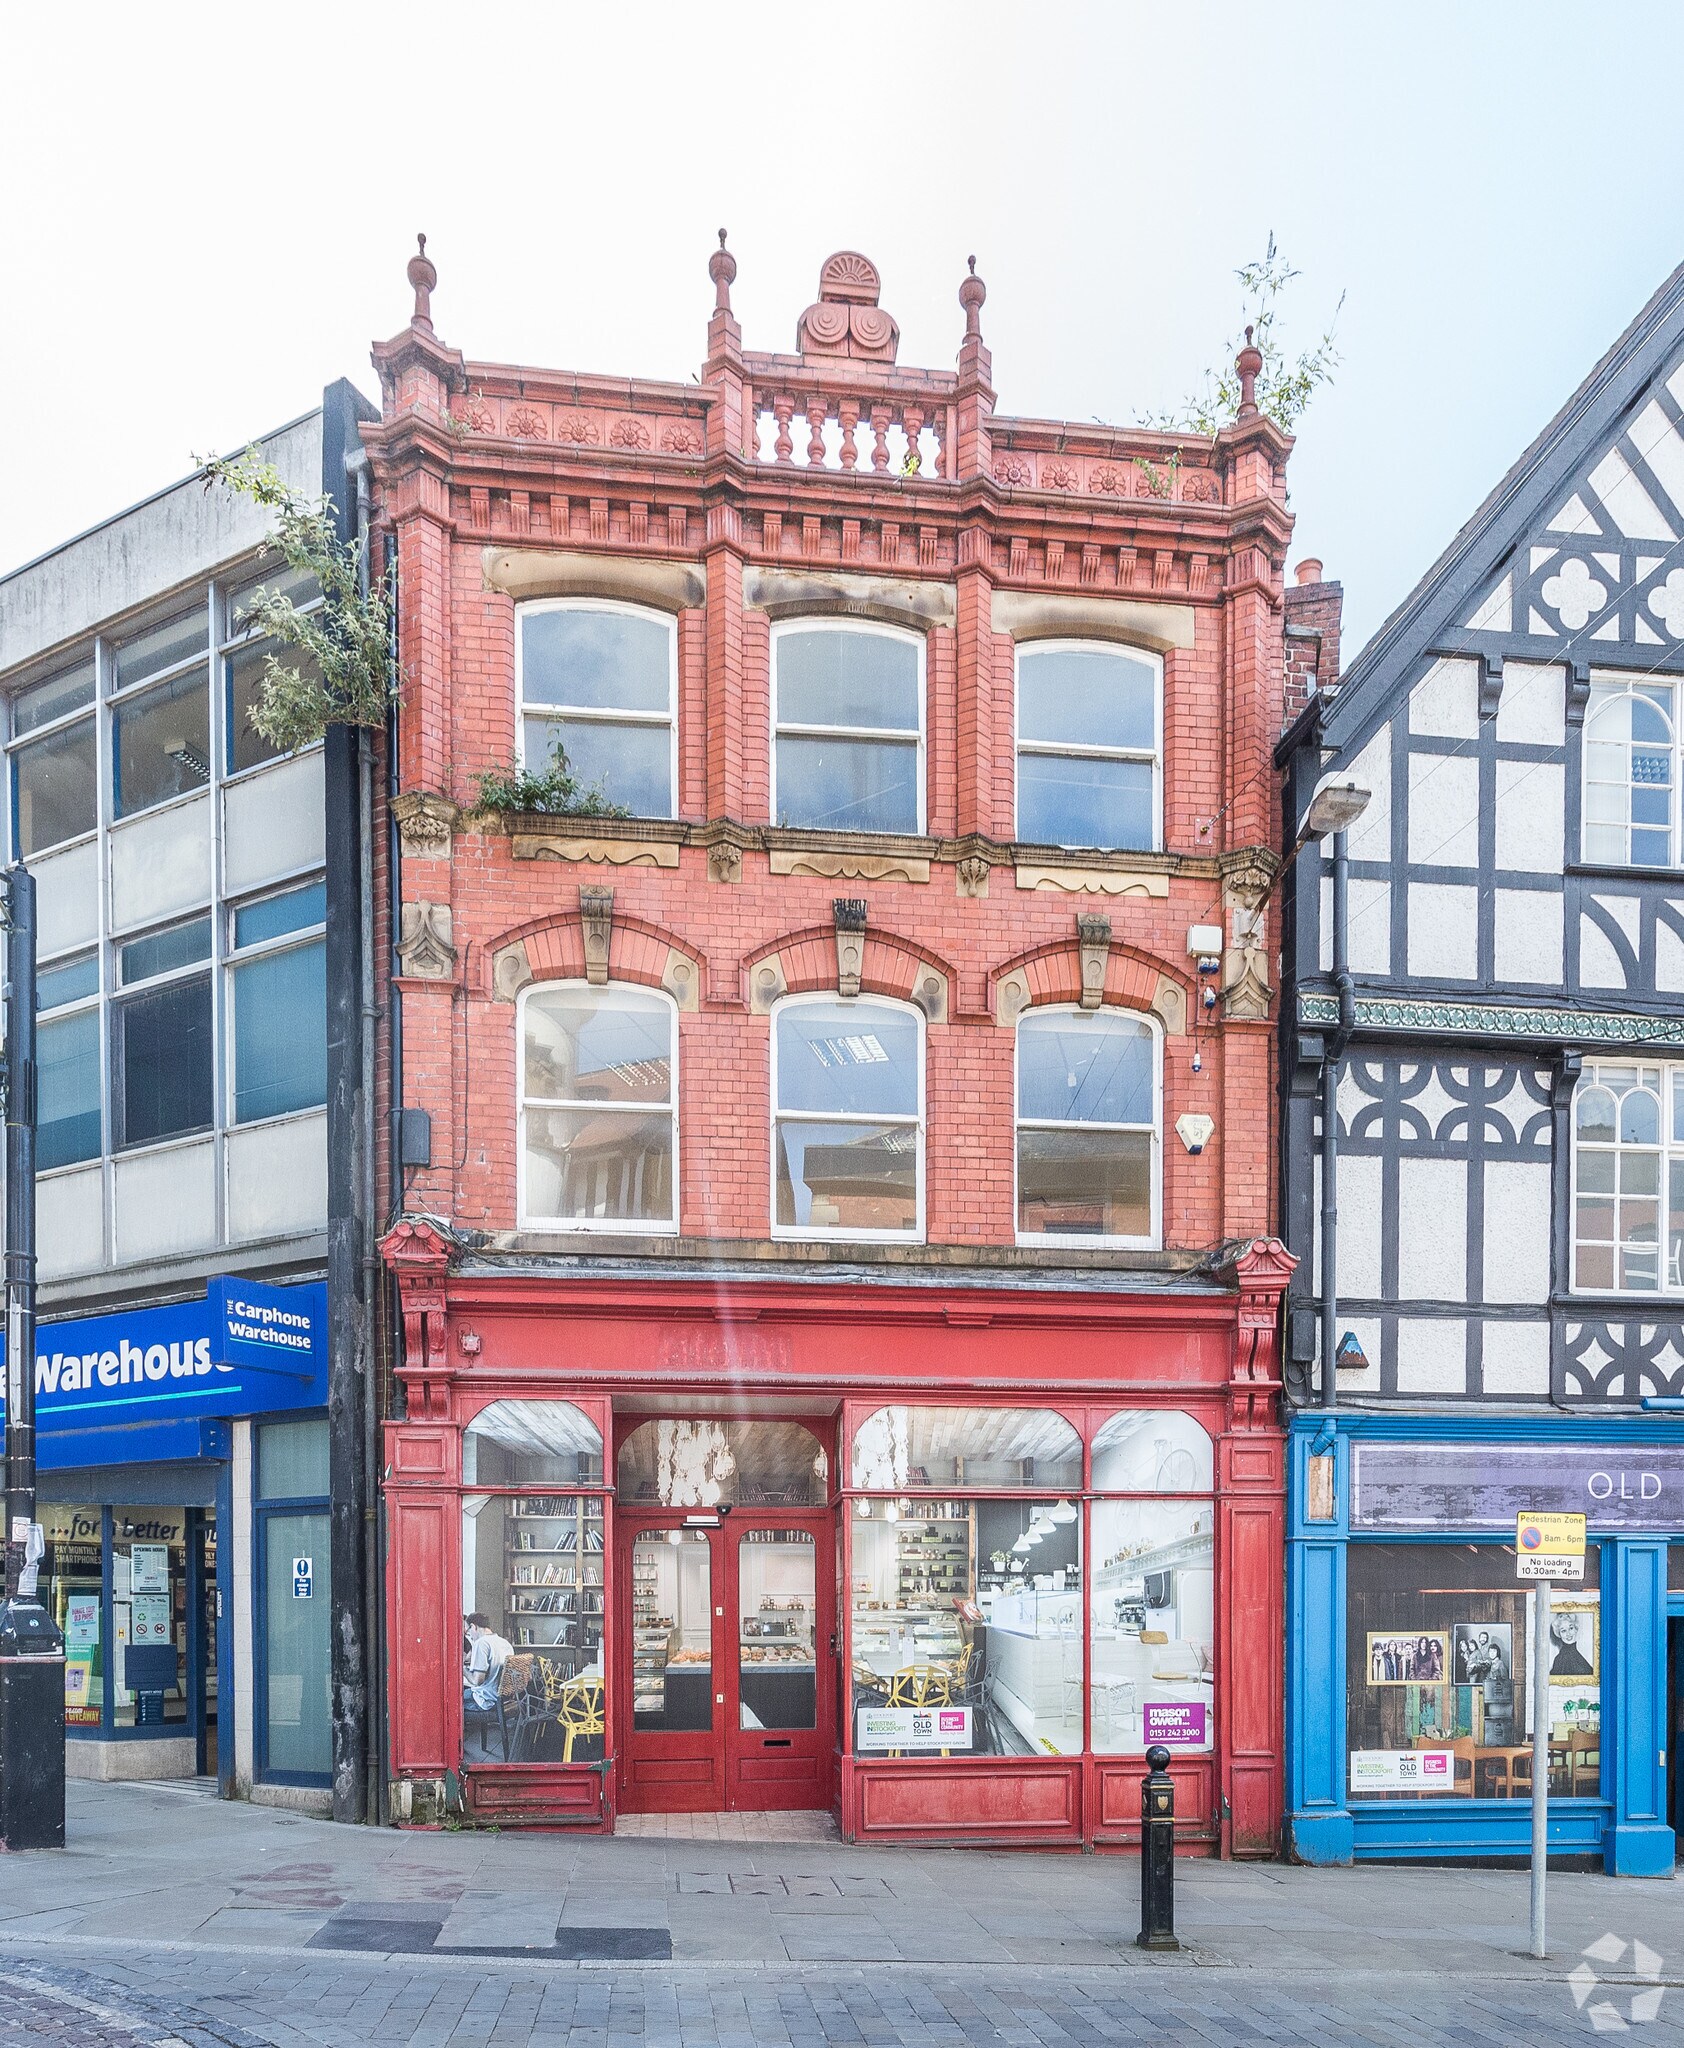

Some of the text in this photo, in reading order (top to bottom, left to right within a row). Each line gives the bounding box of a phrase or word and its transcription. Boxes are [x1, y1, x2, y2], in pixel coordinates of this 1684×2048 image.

[235, 1301, 311, 1330] Carphone
[228, 1321, 311, 1349] Warehouse
[35, 1338, 235, 1394] Warehous
[1587, 1471, 1662, 1500] OLD
[1520, 1514, 1584, 1525] Pedestrian Zone
[122, 1517, 180, 1541] better
[1544, 1534, 1561, 1542] 8am
[1566, 1534, 1584, 1544] 6pm
[54, 1554, 103, 1564] SMARTPHONES
[1529, 1558, 1573, 1568] No loading
[1521, 1566, 1557, 1575] 10.30am
[1562, 1567, 1580, 1577] 4pm
[1149, 1707, 1190, 1717] mason
[913, 1721, 932, 1729] OLD
[1149, 1729, 1166, 1737] 0151
[1182, 1728, 1200, 1736] 3000
[1400, 1763, 1417, 1771] OLD
